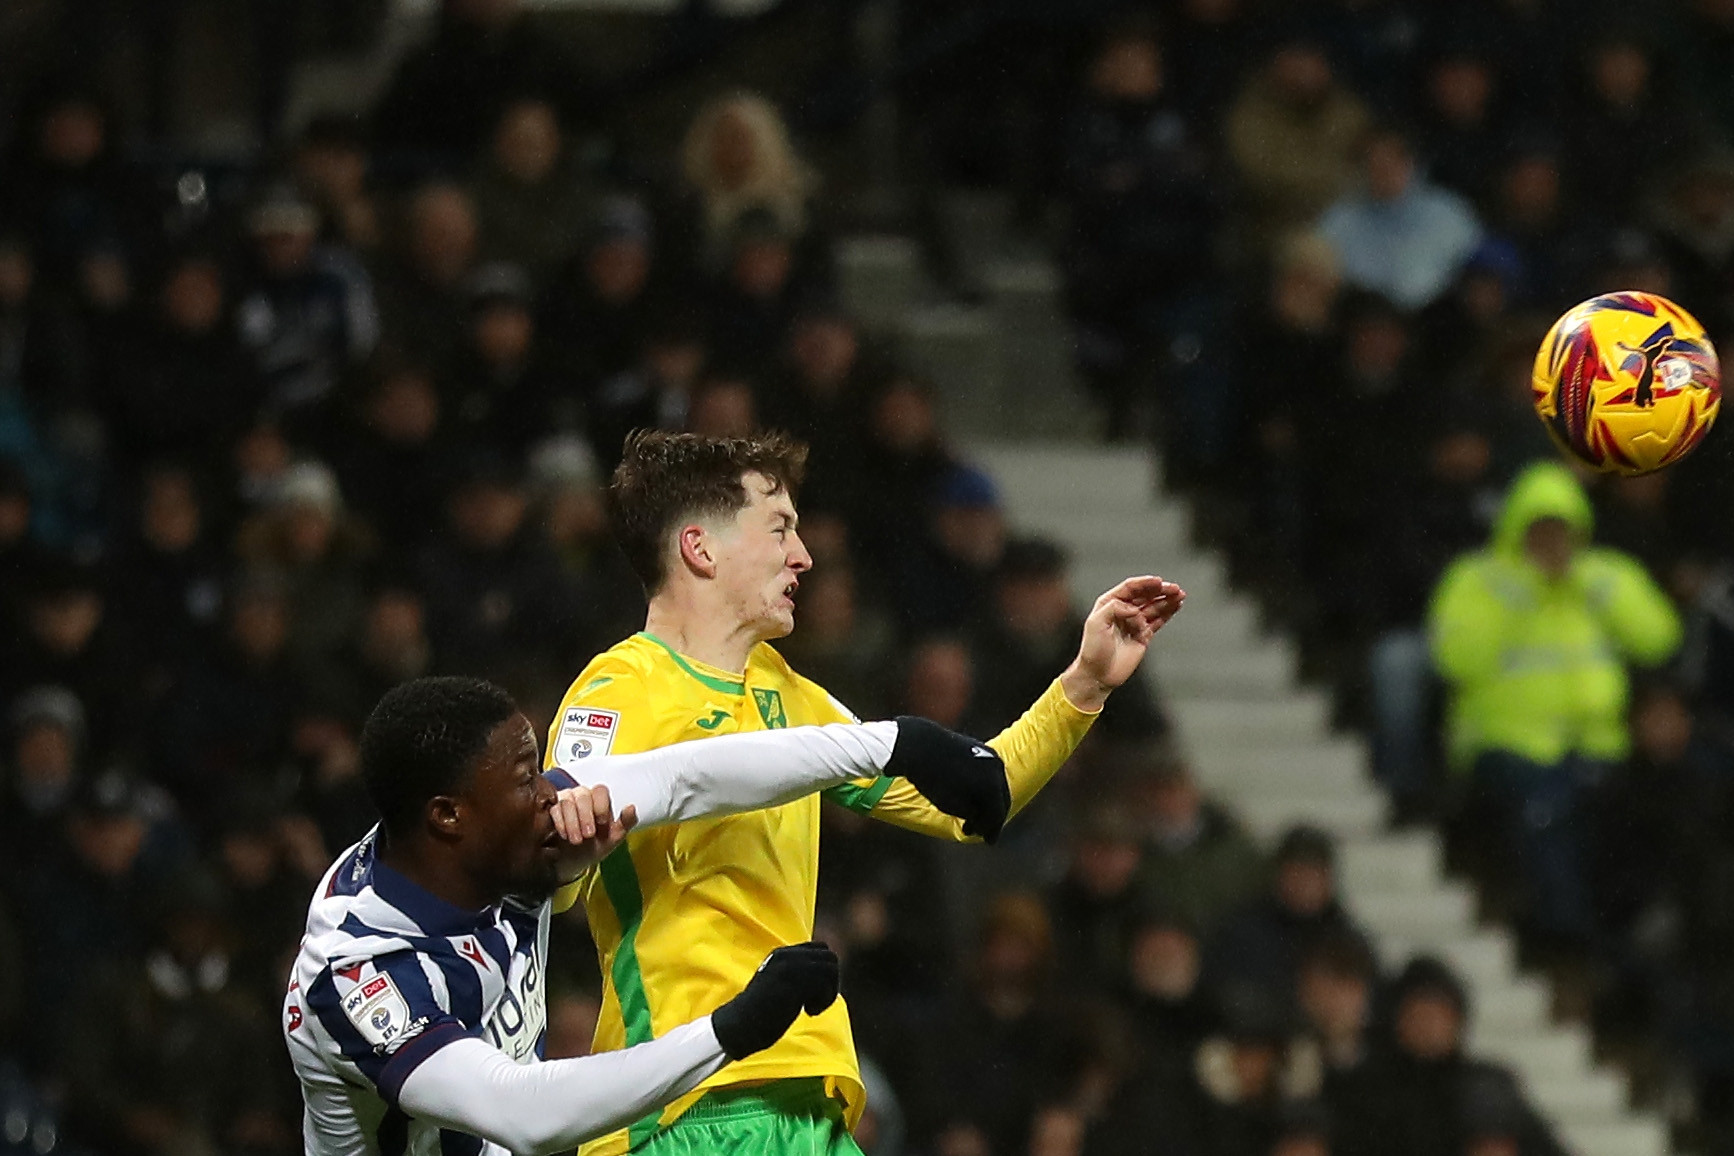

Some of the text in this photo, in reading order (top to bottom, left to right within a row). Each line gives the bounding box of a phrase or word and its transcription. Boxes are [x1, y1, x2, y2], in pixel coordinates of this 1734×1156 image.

[567, 713, 611, 728] sky bet
[347, 979, 386, 1012] sky bet
[382, 1024, 399, 1041] EFL
